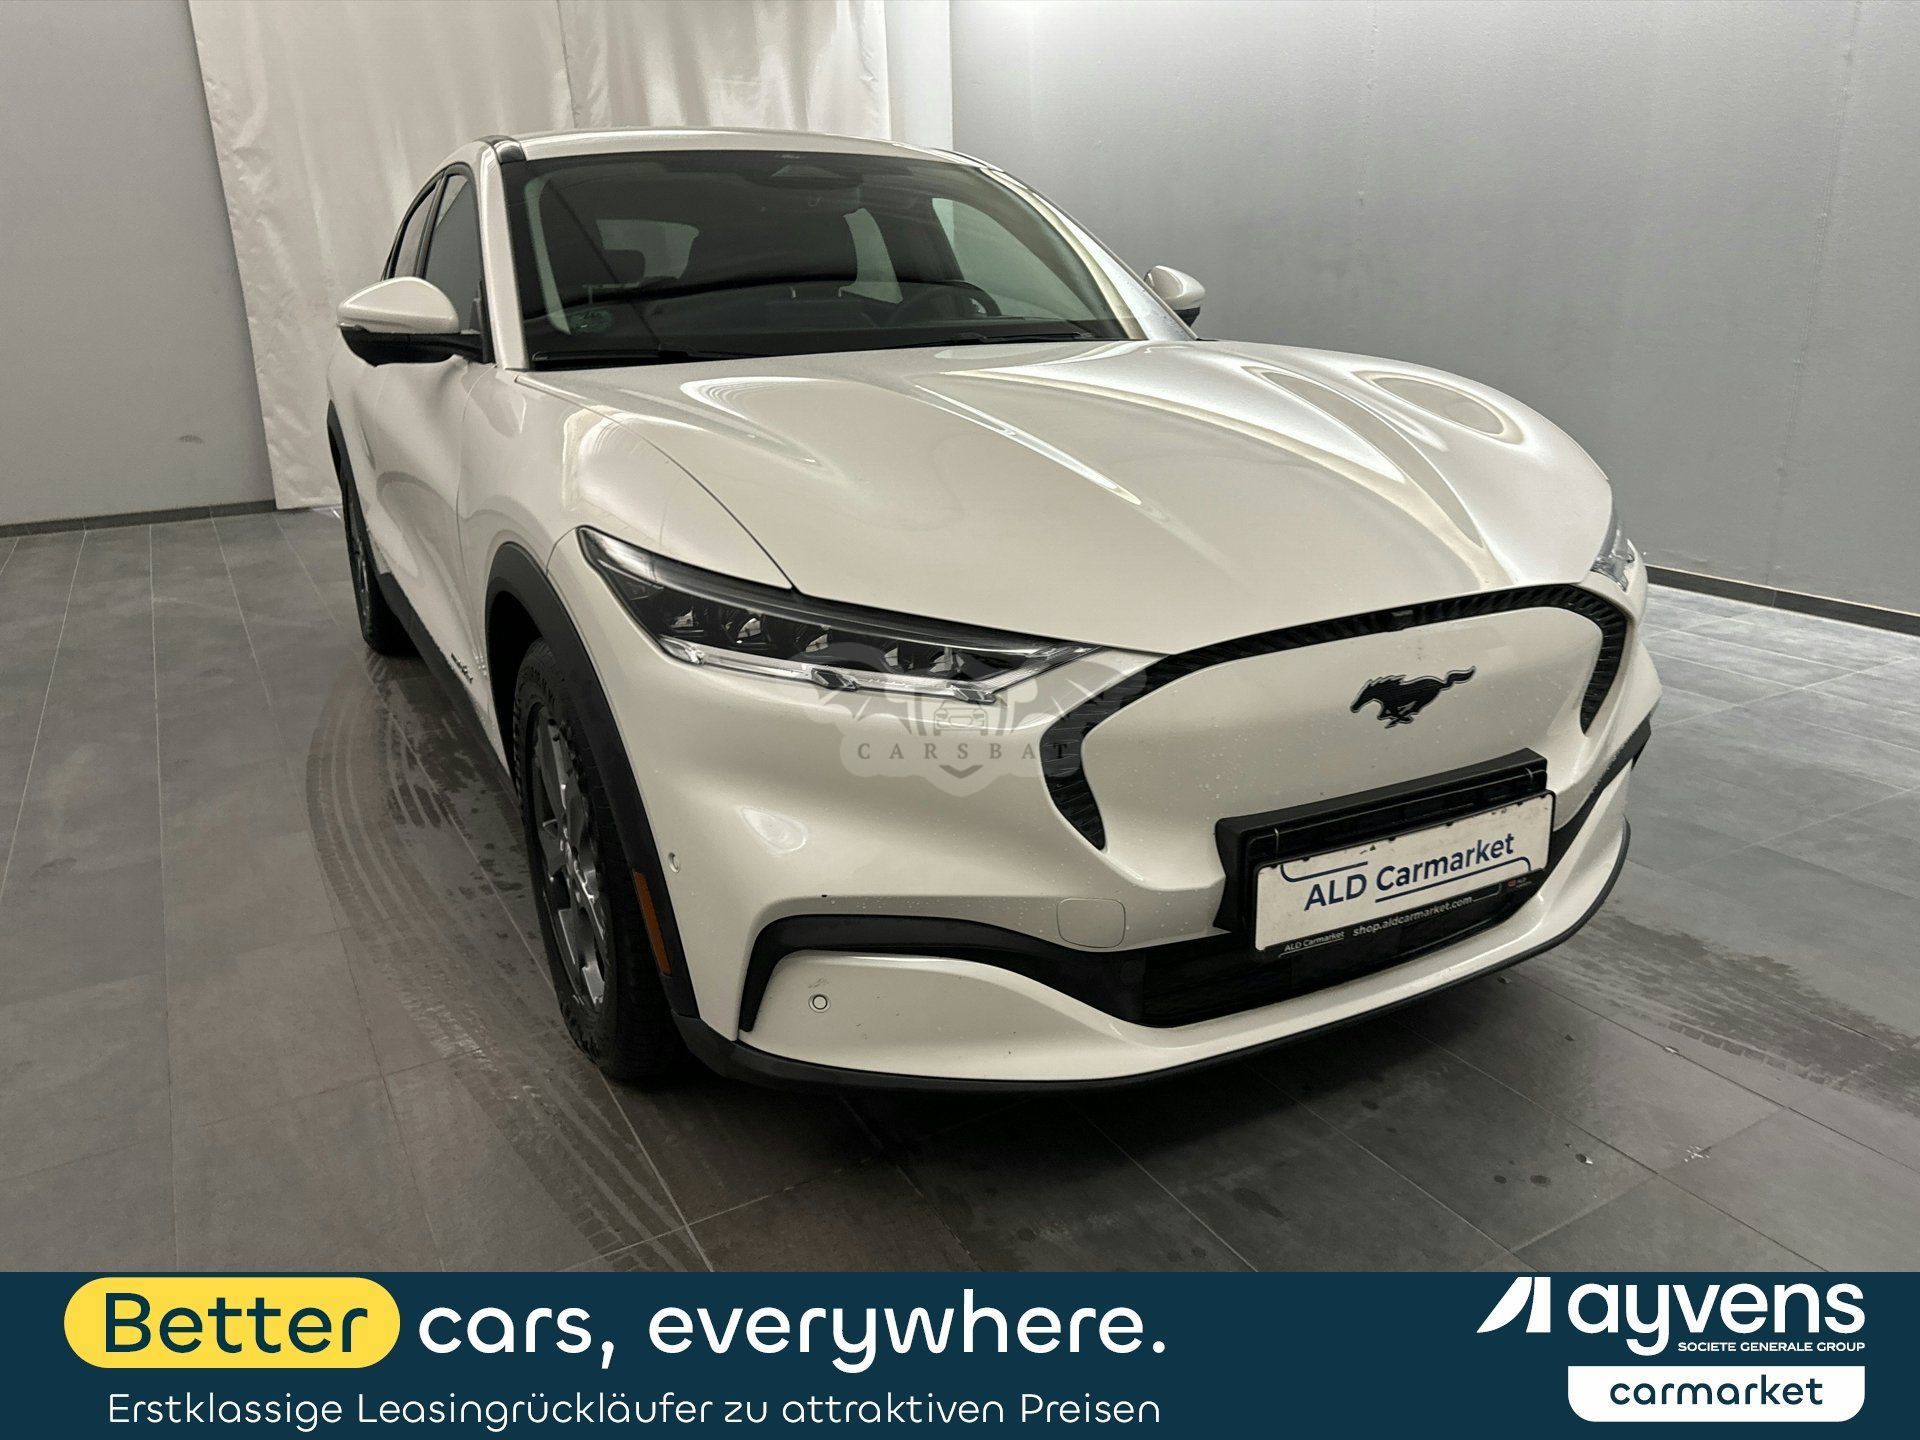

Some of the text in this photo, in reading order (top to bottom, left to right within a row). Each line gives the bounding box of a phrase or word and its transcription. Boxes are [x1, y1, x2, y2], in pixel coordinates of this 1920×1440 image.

[1304, 832, 1514, 911] ALD Carmarket
[1352, 896, 1474, 937] shop.aldcarmarket.com
[1284, 930, 1345, 952] ALD Carmarket
